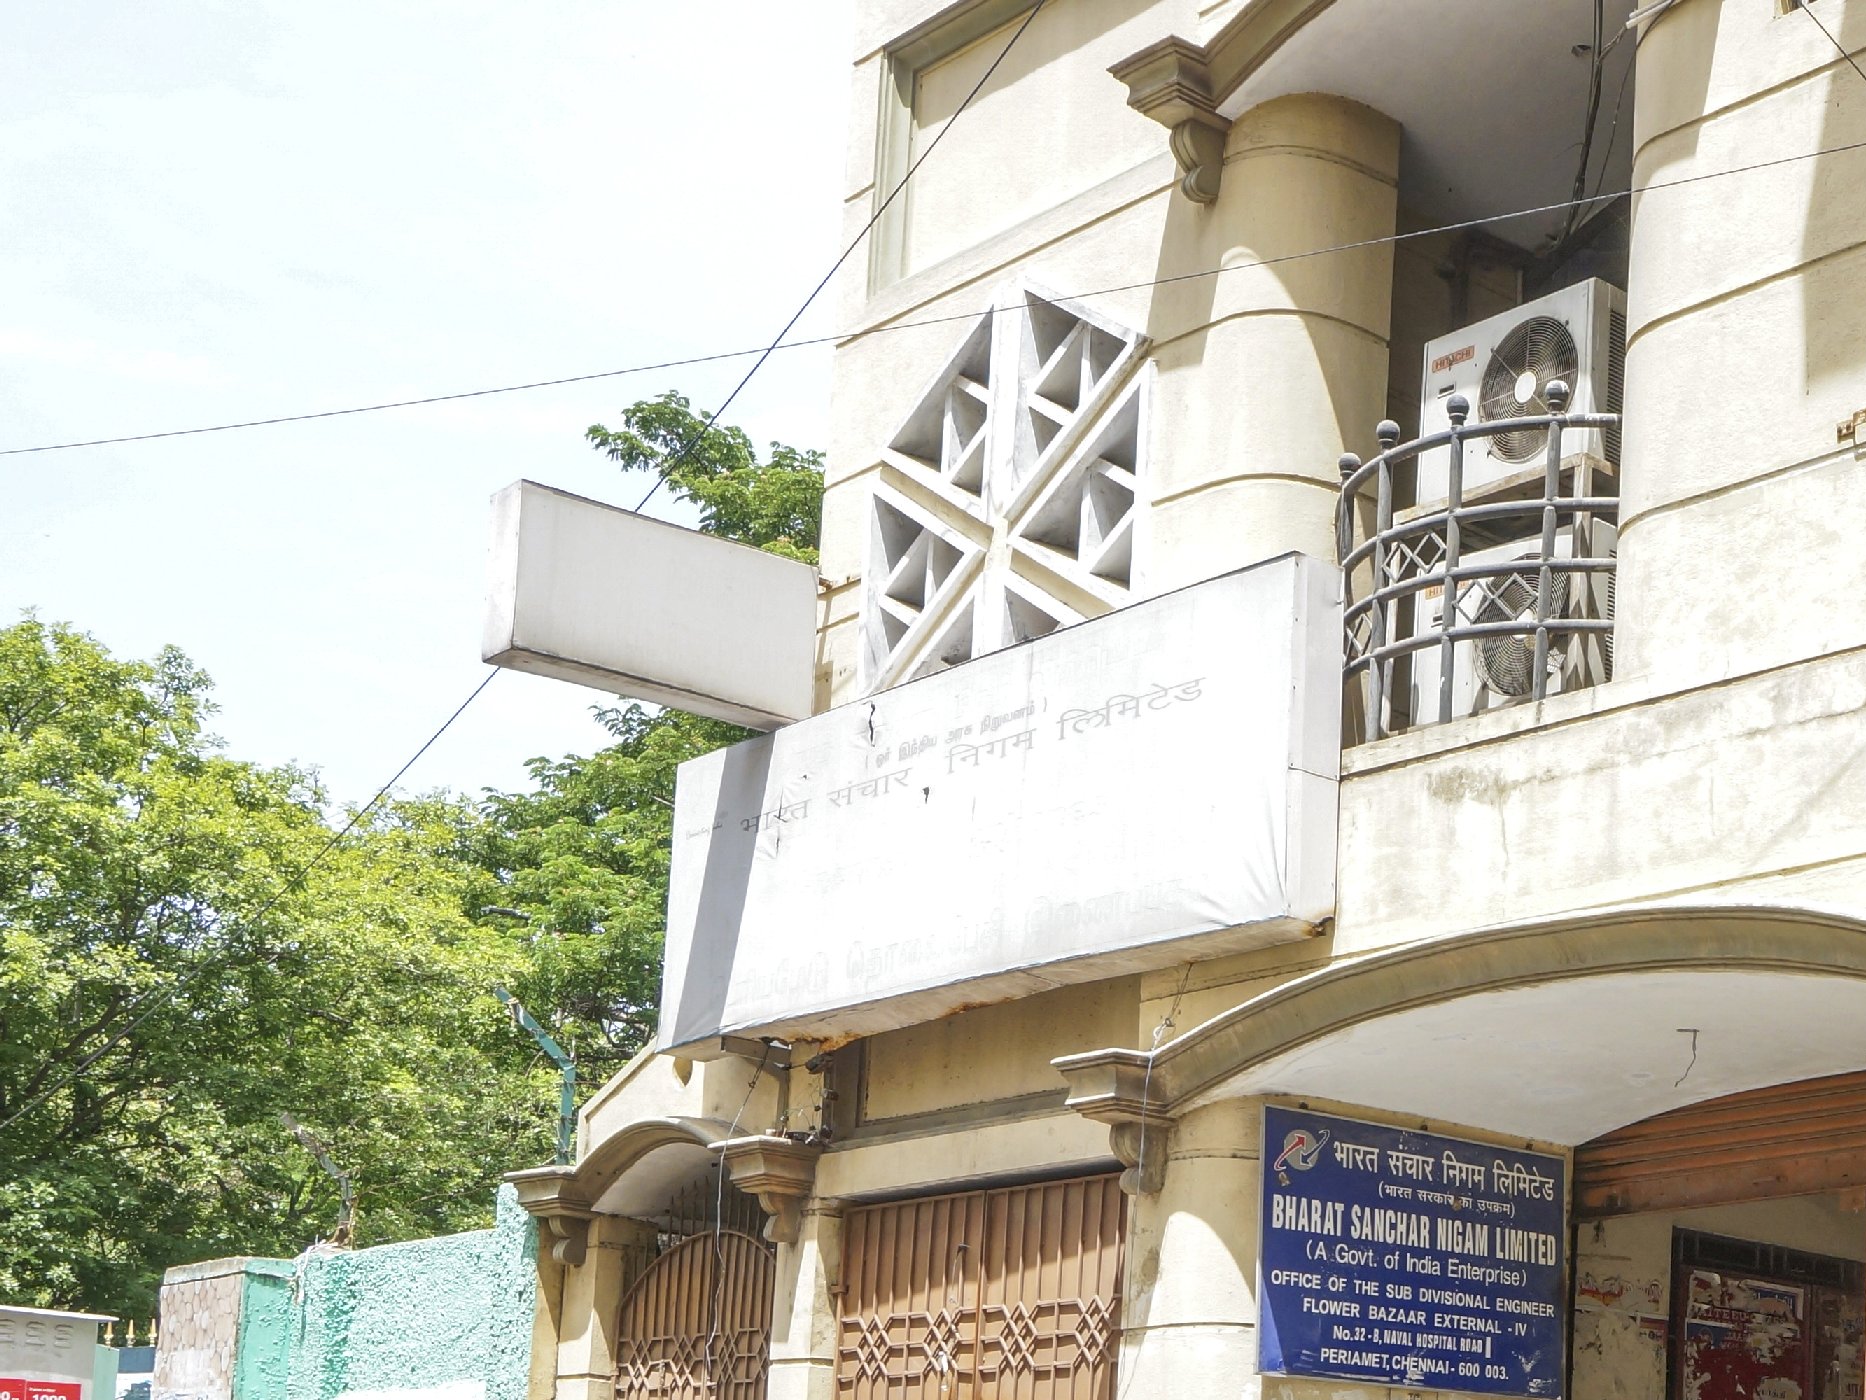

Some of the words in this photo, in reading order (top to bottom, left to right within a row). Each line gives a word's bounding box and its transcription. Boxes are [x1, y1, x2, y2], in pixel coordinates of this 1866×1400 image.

[740, 799, 811, 833] भारत
[827, 767, 913, 807] संचार
[945, 728, 1037, 774] निगम
[1056, 677, 1207, 741] लिमिटेड
[1334, 1141, 1379, 1173] भारत
[1387, 1144, 1435, 1182] संचार
[1442, 1150, 1485, 1190] निगम
[1493, 1160, 1554, 1201] लिमिटेड
[1378, 1181, 1413, 1200] (भारत
[1417, 1189, 1455, 1206] सरकार
[1477, 1200, 1515, 1218] उपक्रम)
[1272, 1194, 1344, 1236] BHARAT
[1350, 1204, 1430, 1248] SANCHAR
[1437, 1218, 1489, 1257] NIGAM
[1496, 1227, 1556, 1266] LIMITED
[1306, 1240, 1327, 1260] (A
[1335, 1244, 1377, 1267] Govt.
[1384, 1253, 1400, 1270] of
[1407, 1253, 1441, 1276] India
[1448, 1258, 1527, 1287] Enterprise)
[1271, 1270, 1321, 1289] OFFICE
[1328, 1276, 1347, 1292] OF
[1354, 1280, 1379, 1296] THE
[1386, 1284, 1412, 1300] SUB
[1419, 1288, 1491, 1310] DIVISIONAL
[1496, 1298, 1555, 1317] ENGINEER
[1303, 1298, 1360, 1318] FLOWER
[1369, 1305, 1426, 1325] BAZAAR
[1434, 1313, 1502, 1334] EXTERNAL
[1384, 1330, 1412, 1347] NAVAL
[1416, 1333, 1457, 1351] HOSPITAL
[1460, 1338, 1482, 1353] ROAD
[1459, 1362, 1480, 1377] 600
[1485, 1367, 1509, 1380] 003.
